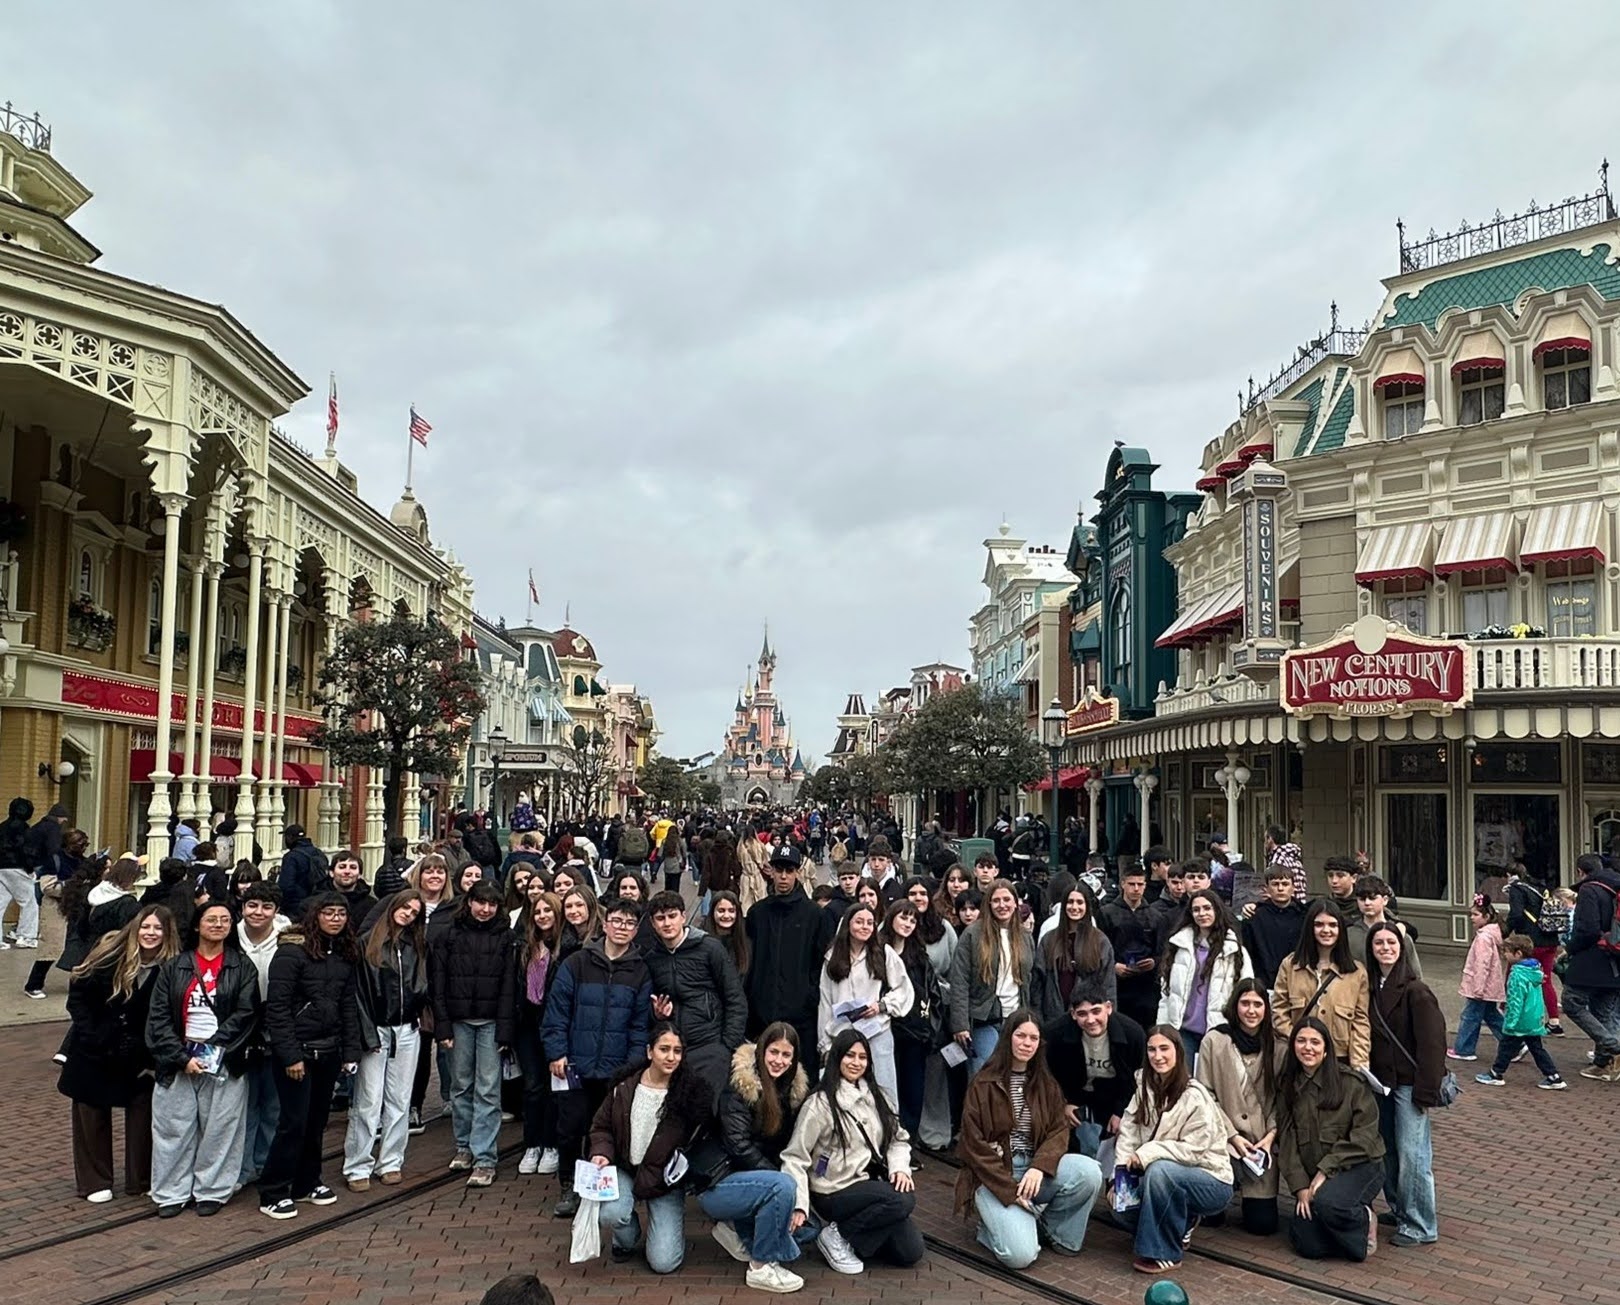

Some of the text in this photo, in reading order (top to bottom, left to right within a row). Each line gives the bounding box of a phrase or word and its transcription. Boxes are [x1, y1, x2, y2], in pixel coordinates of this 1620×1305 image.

[1260, 514, 1272, 624] SOUVENIRS
[1290, 650, 1458, 699] NEW CENTURY
[1329, 677, 1412, 698] NOTIONS
[1345, 701, 1395, 715] FLORA'S
[504, 753, 543, 761] MPORIUM
